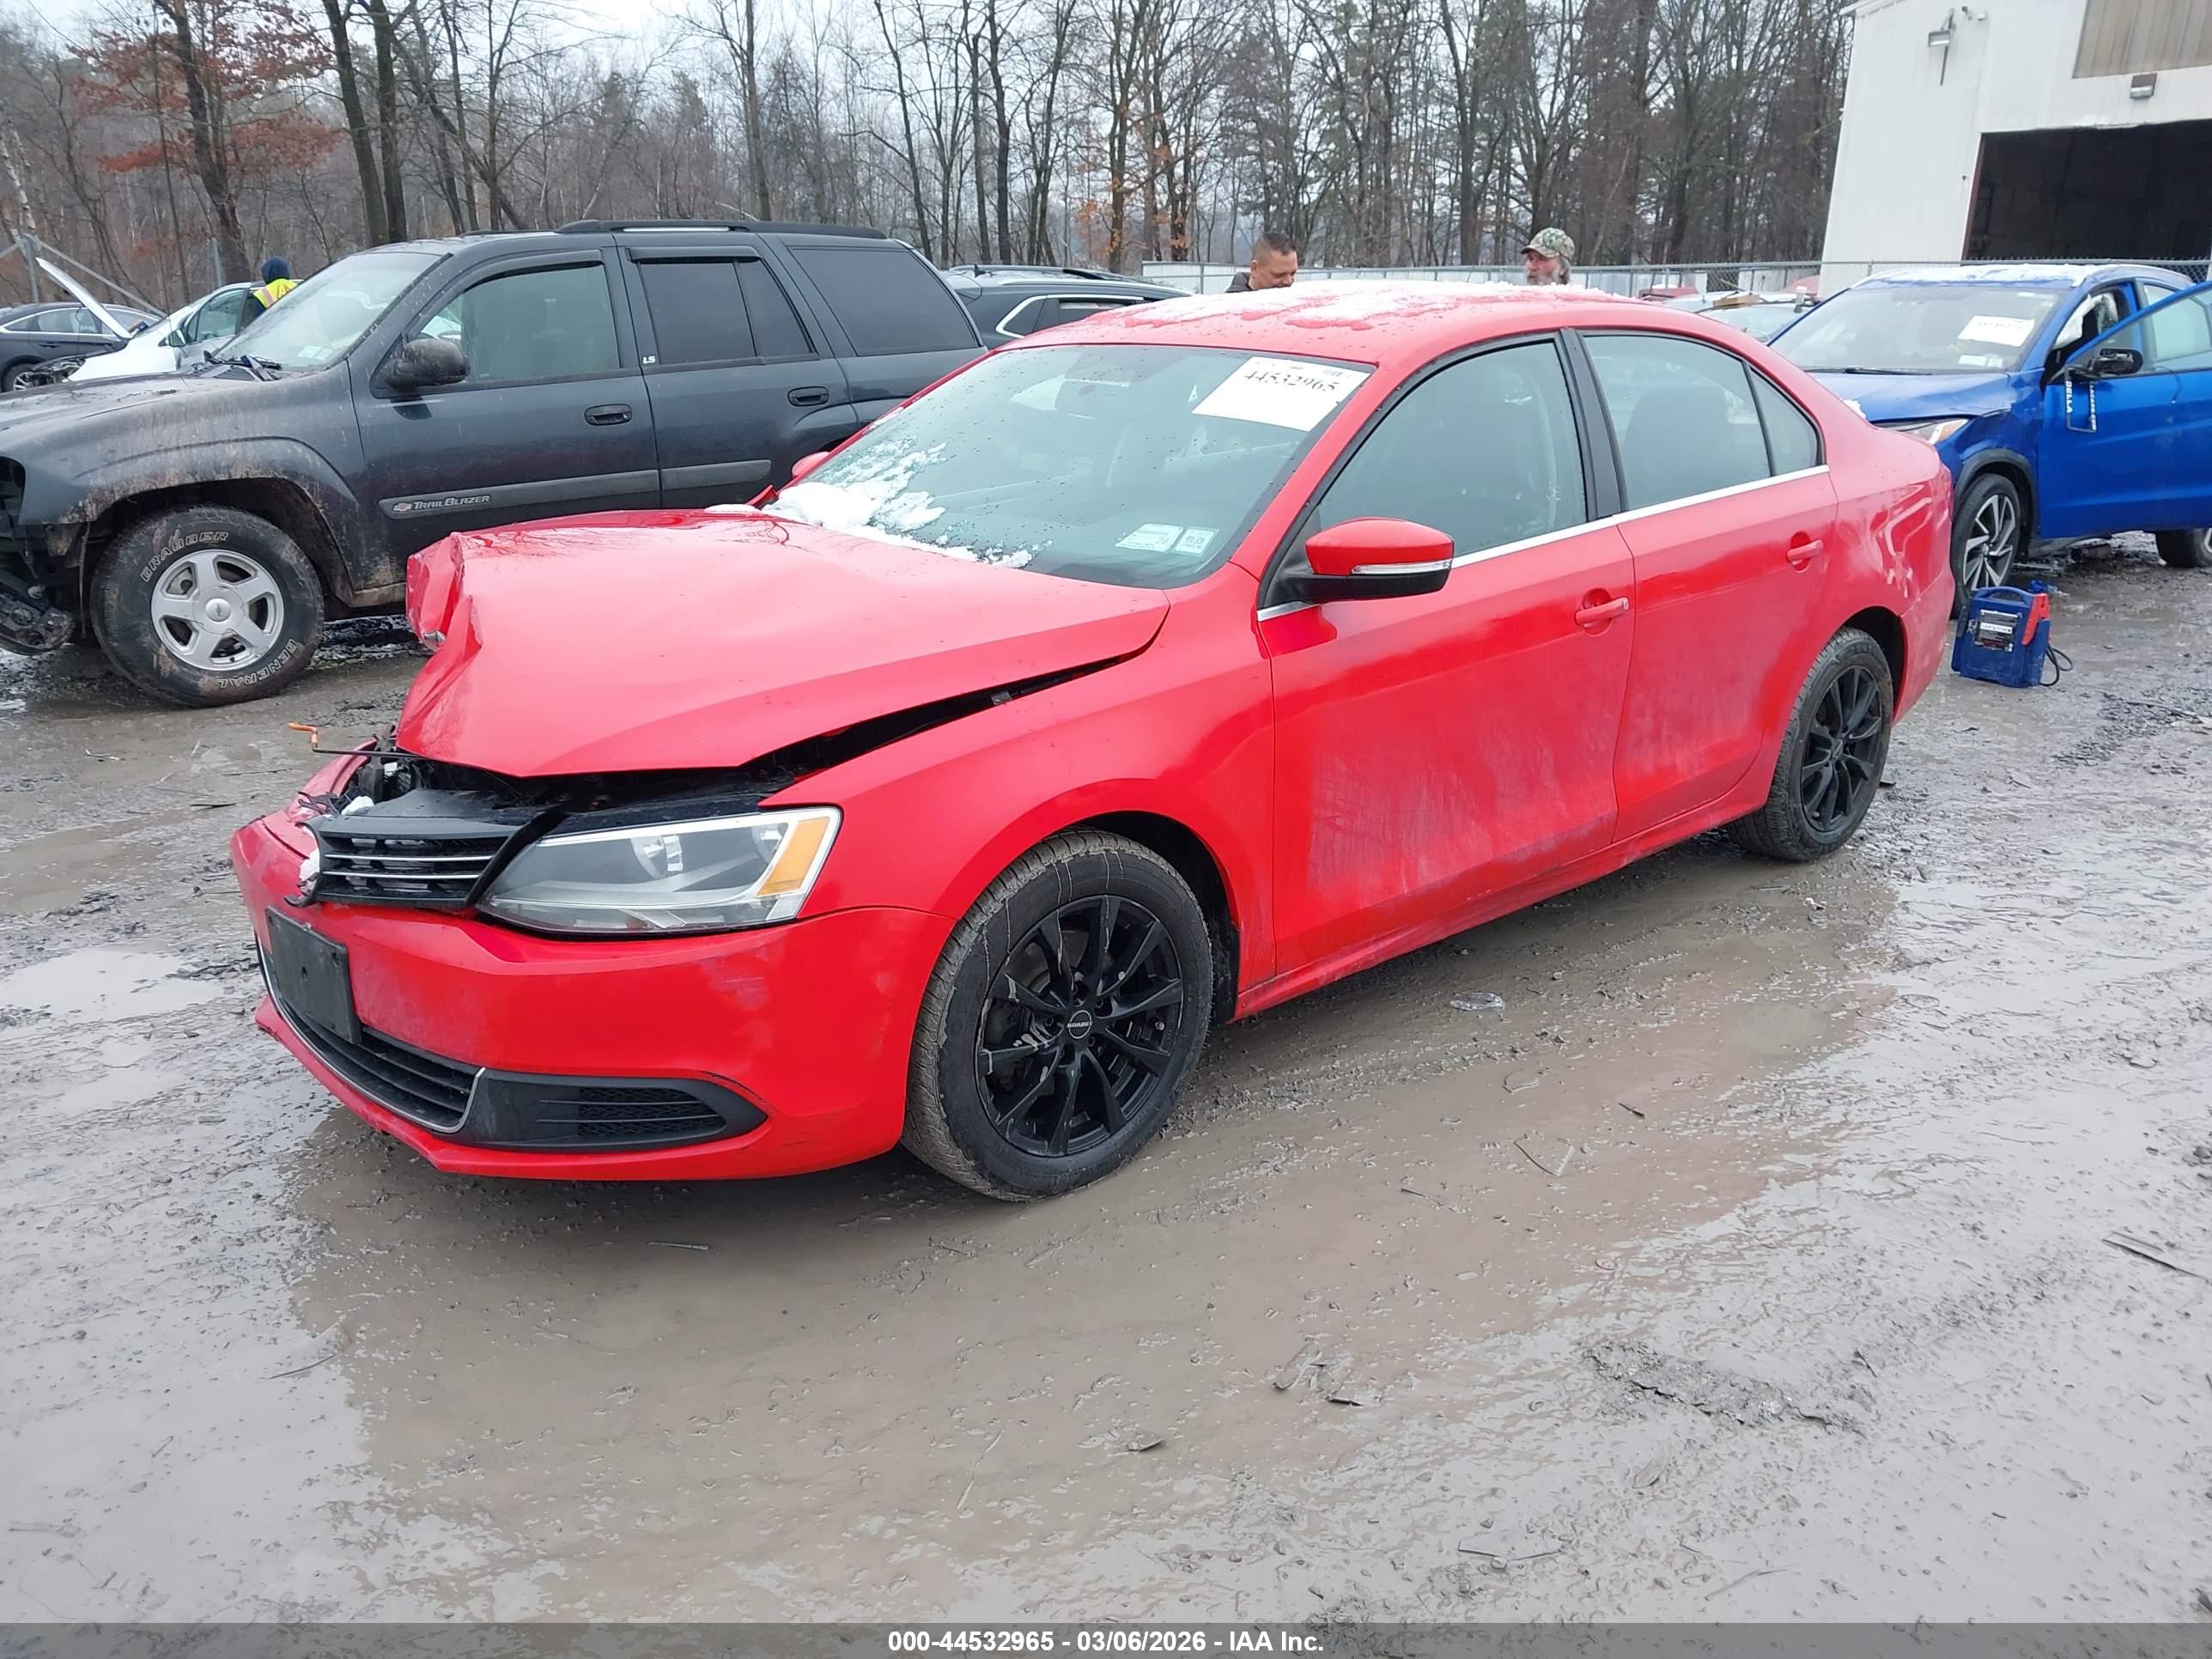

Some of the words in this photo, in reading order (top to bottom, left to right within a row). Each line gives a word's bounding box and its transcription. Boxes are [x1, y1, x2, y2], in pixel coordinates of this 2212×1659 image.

[642, 356, 655, 364] LS
[140, 532, 228, 582] GRABBER
[218, 639, 296, 688] GENERAL
